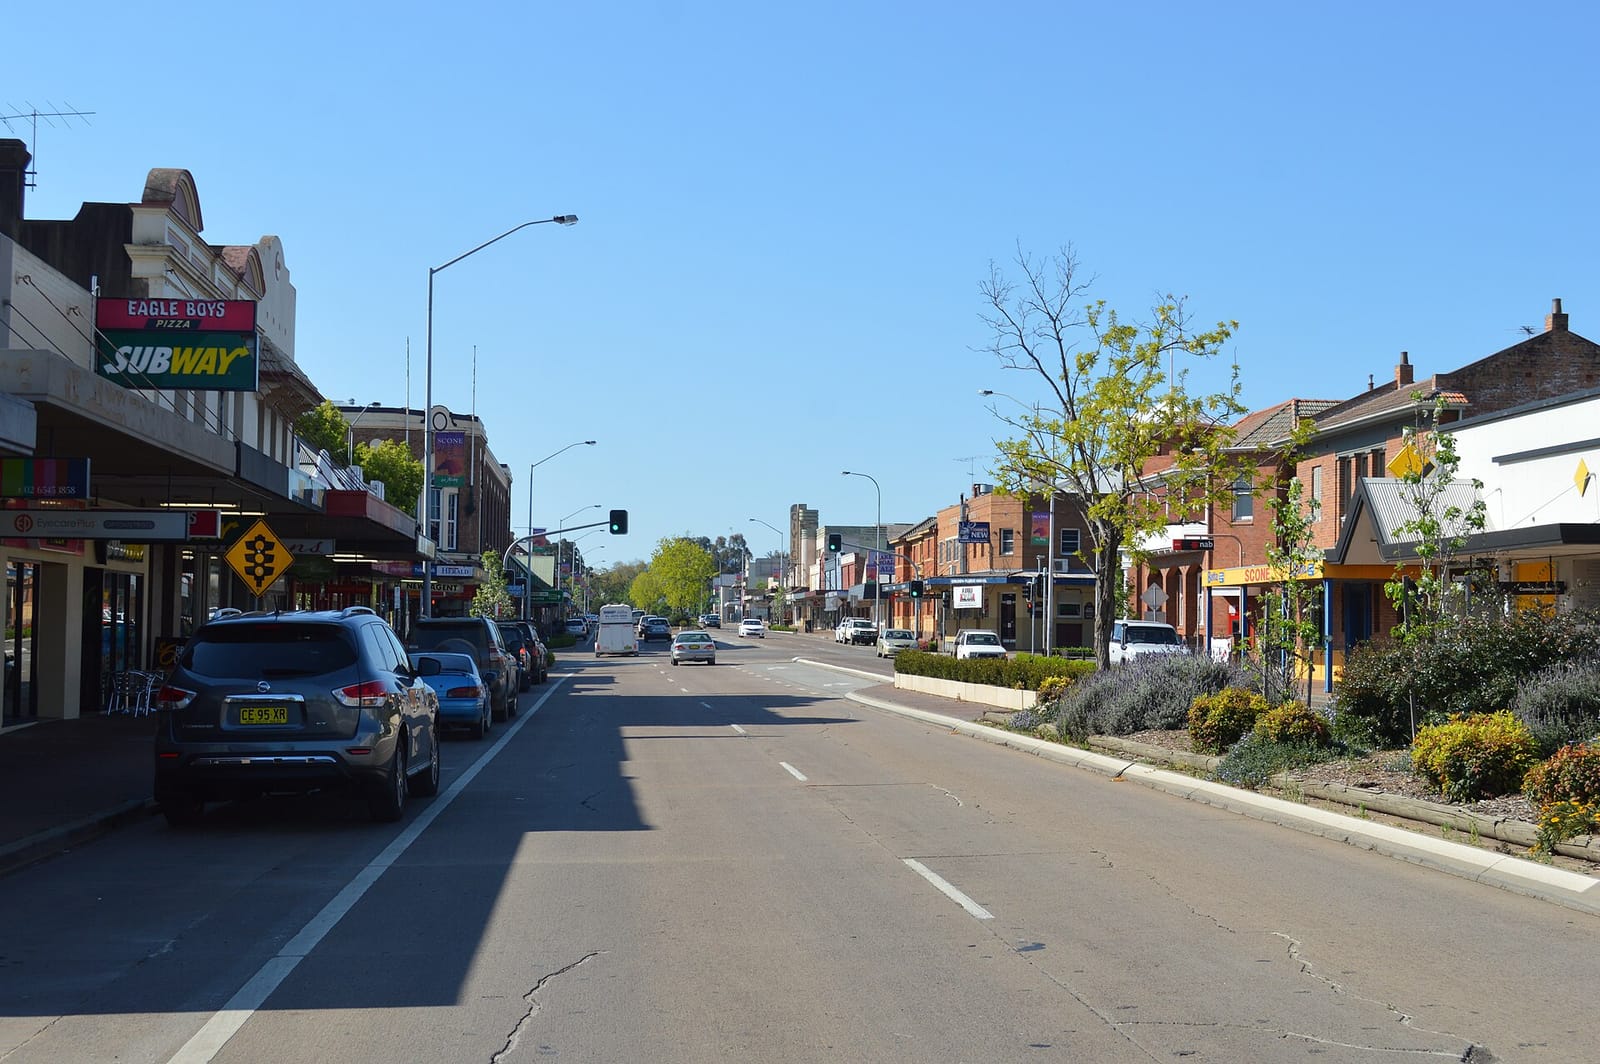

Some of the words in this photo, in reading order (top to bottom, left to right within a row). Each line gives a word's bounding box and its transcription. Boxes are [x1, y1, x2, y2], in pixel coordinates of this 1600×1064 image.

[128, 301, 178, 316] EAGLE
[186, 302, 225, 317] BOYS
[156, 319, 190, 328] PIZZA
[103, 345, 249, 375] SUBWAY
[1244, 567, 1270, 582] SCONE
